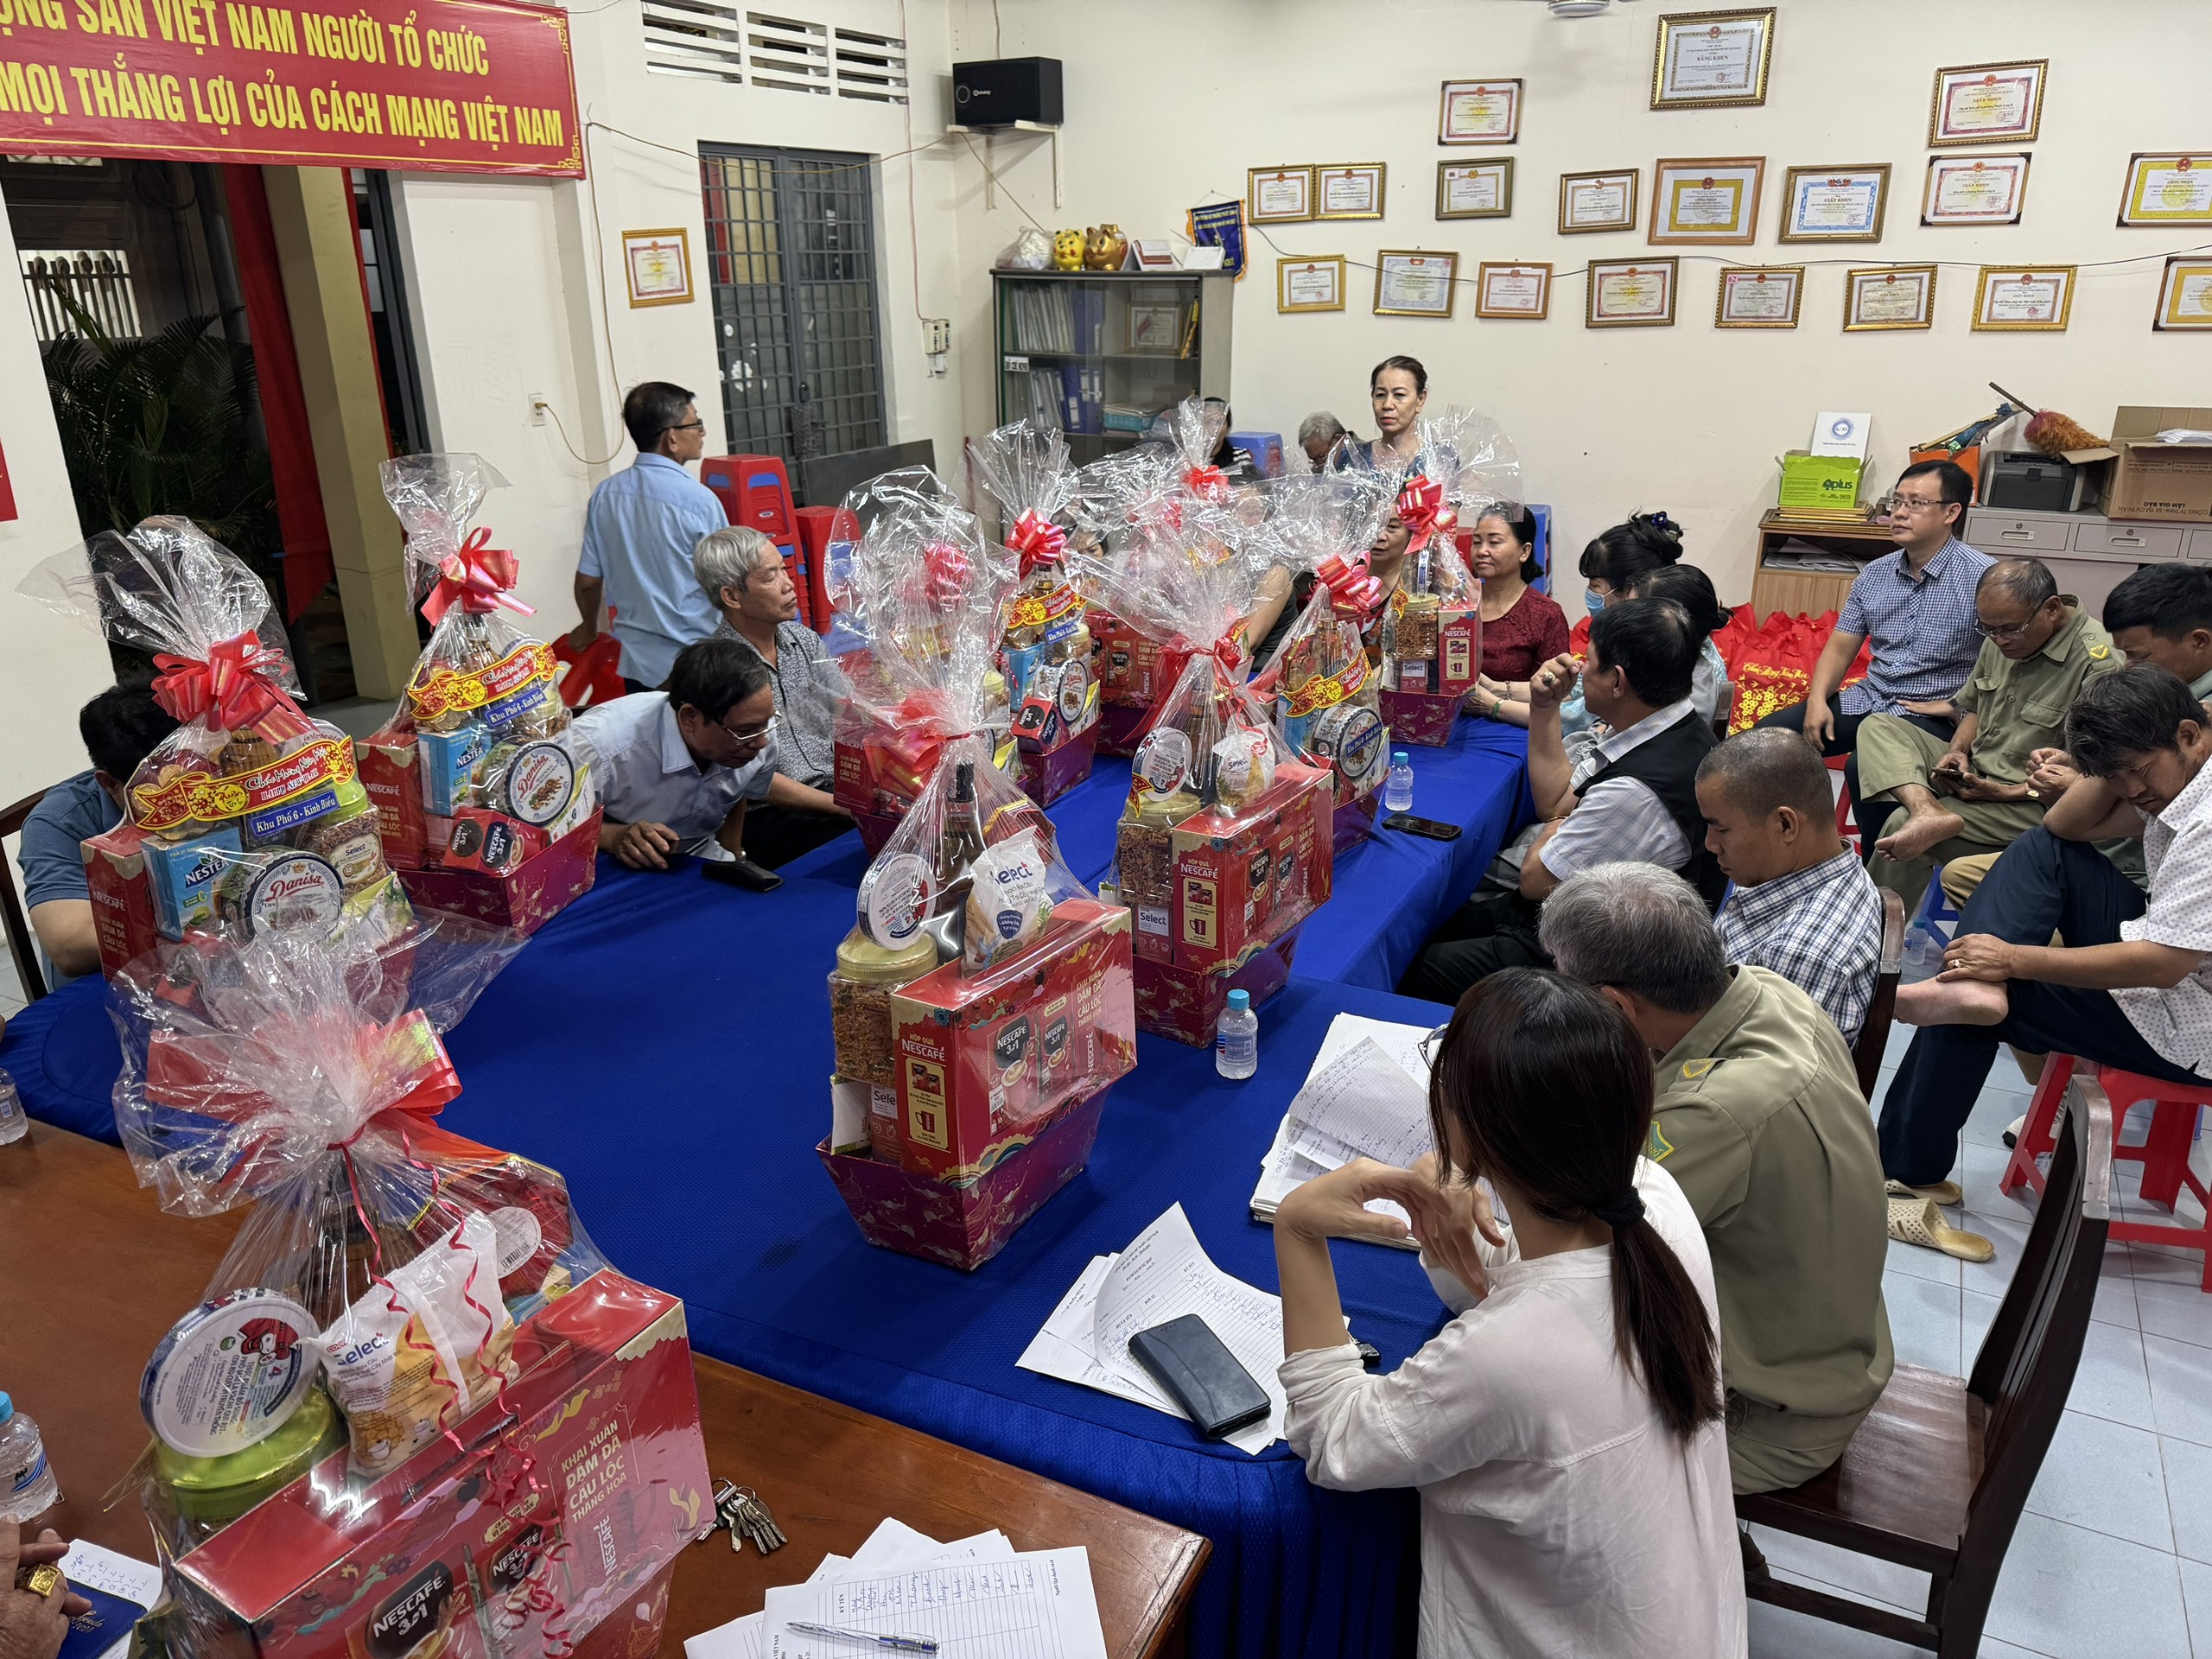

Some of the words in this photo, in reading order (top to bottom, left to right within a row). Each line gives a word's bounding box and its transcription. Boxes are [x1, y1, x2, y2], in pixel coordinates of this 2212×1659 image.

[225, 2, 298, 54] NAM
[301, 9, 386, 64] NGƯỜI
[388, 10, 423, 67] TỔ
[426, 25, 489, 75] CHỨC
[0, 60, 69, 125] MỌI
[69, 52, 187, 123] THẮNG
[188, 74, 241, 135] LỢI
[245, 68, 308, 130] CỦA
[310, 79, 383, 134] CÁCH
[385, 94, 461, 147] MẠNG
[461, 95, 509, 150] VIỆT
[513, 105, 564, 147] NAM
[490, 712, 505, 723] Khu
[505, 703, 518, 716] Phố
[456, 748, 484, 768] NESTEA
[366, 783, 400, 796] NESCAFÉ
[518, 754, 549, 799] Danisa
[256, 819, 275, 833] Khu
[276, 810, 292, 826] Phố
[293, 810, 299, 820] 6
[346, 843, 366, 856] Select
[486, 825, 503, 863] NESCAFÉ
[185, 858, 230, 887] NESTEA
[1180, 862, 1218, 879] NESCAFÉ
[265, 872, 325, 902] Danisa
[92, 891, 126, 912] NESCAFÉ
[1140, 912, 1166, 925] Select
[1077, 1001, 1090, 1018] CẦU
[1090, 995, 1103, 1010] LỘC
[997, 1020, 1027, 1050] NESCAFÉ
[1045, 1020, 1065, 1041] NESCAFÉ
[901, 1039, 946, 1062] NESCAFÉ
[1085, 1031, 1095, 1073] NESCAFÉ
[874, 1090, 896, 1106] Sele
[562, 1448, 588, 1473] KHAI
[588, 1420, 619, 1452] XUÂN
[566, 1452, 599, 1491] ĐẬM
[569, 1479, 597, 1510] CẦU
[600, 1454, 626, 1484] LỘC
[607, 1471, 627, 1495] HOA
[594, 1514, 618, 1577] NESCAFÉ
[372, 1568, 445, 1639] NESCAFÉ
